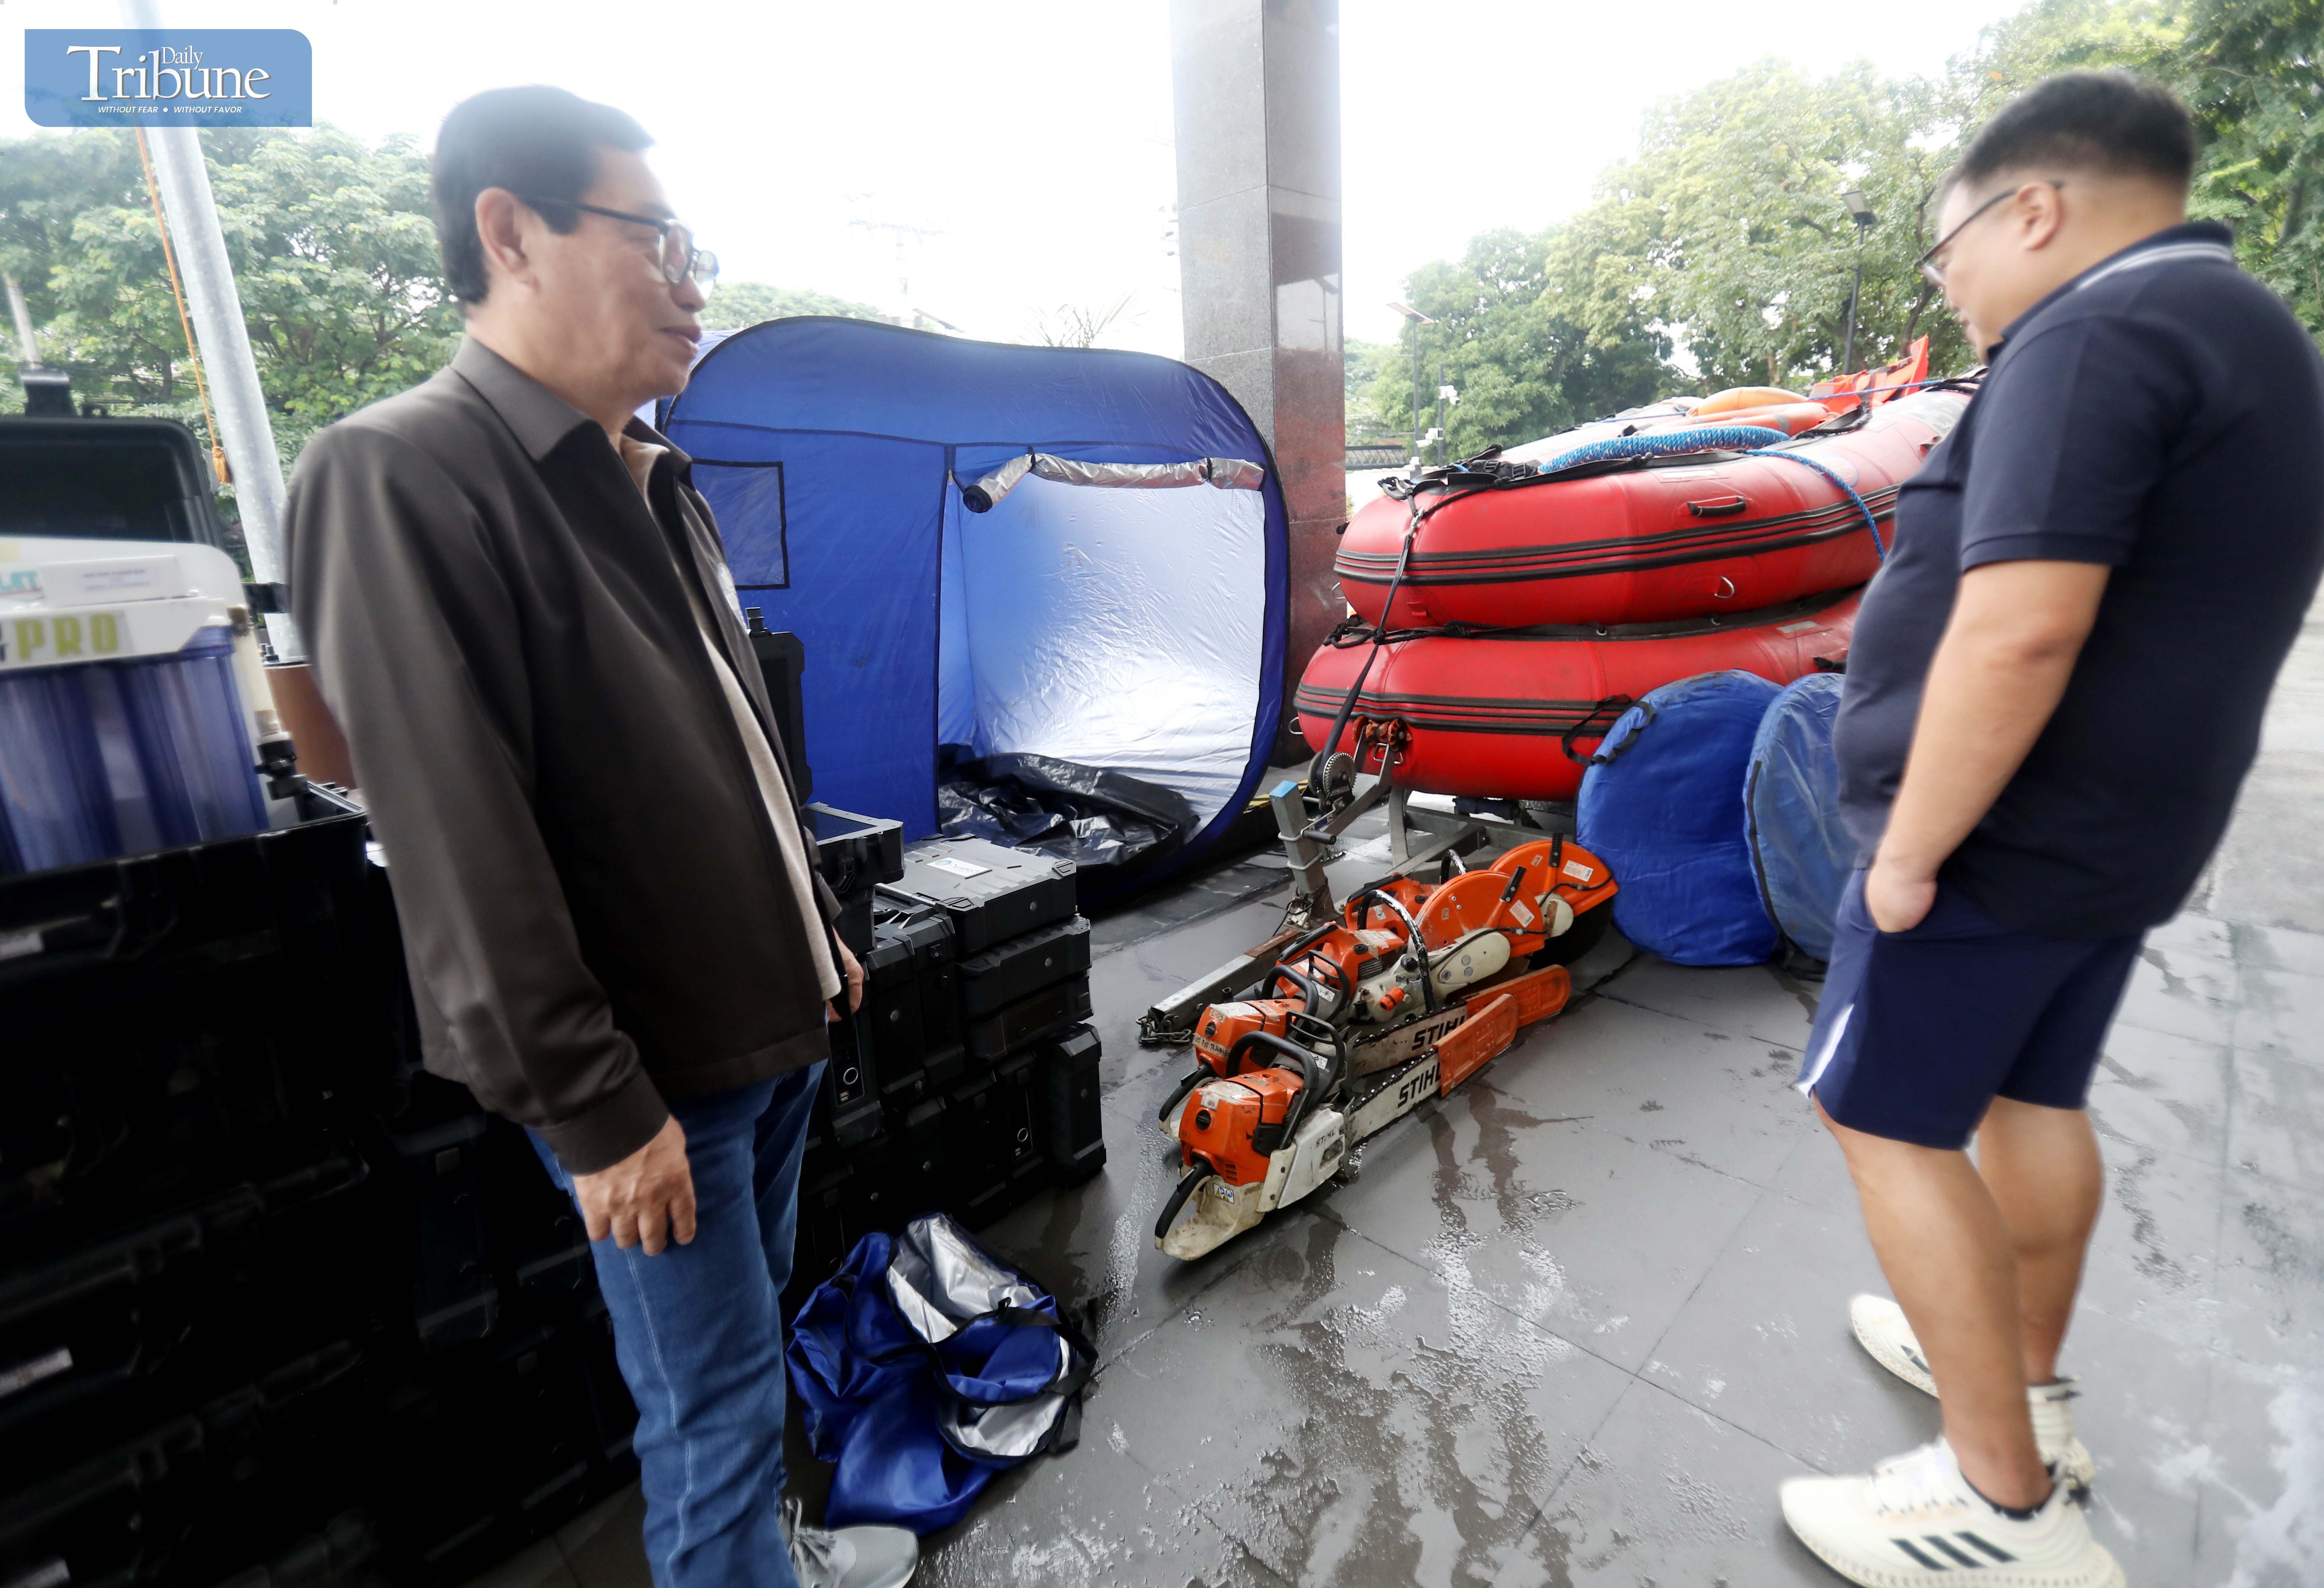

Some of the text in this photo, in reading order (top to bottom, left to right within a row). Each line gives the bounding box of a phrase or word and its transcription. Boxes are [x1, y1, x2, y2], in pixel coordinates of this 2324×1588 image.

[14, 614, 118, 661] PRO
[1211, 1010, 1224, 1020] C-03
[1398, 1062, 1441, 1108] STIHL
